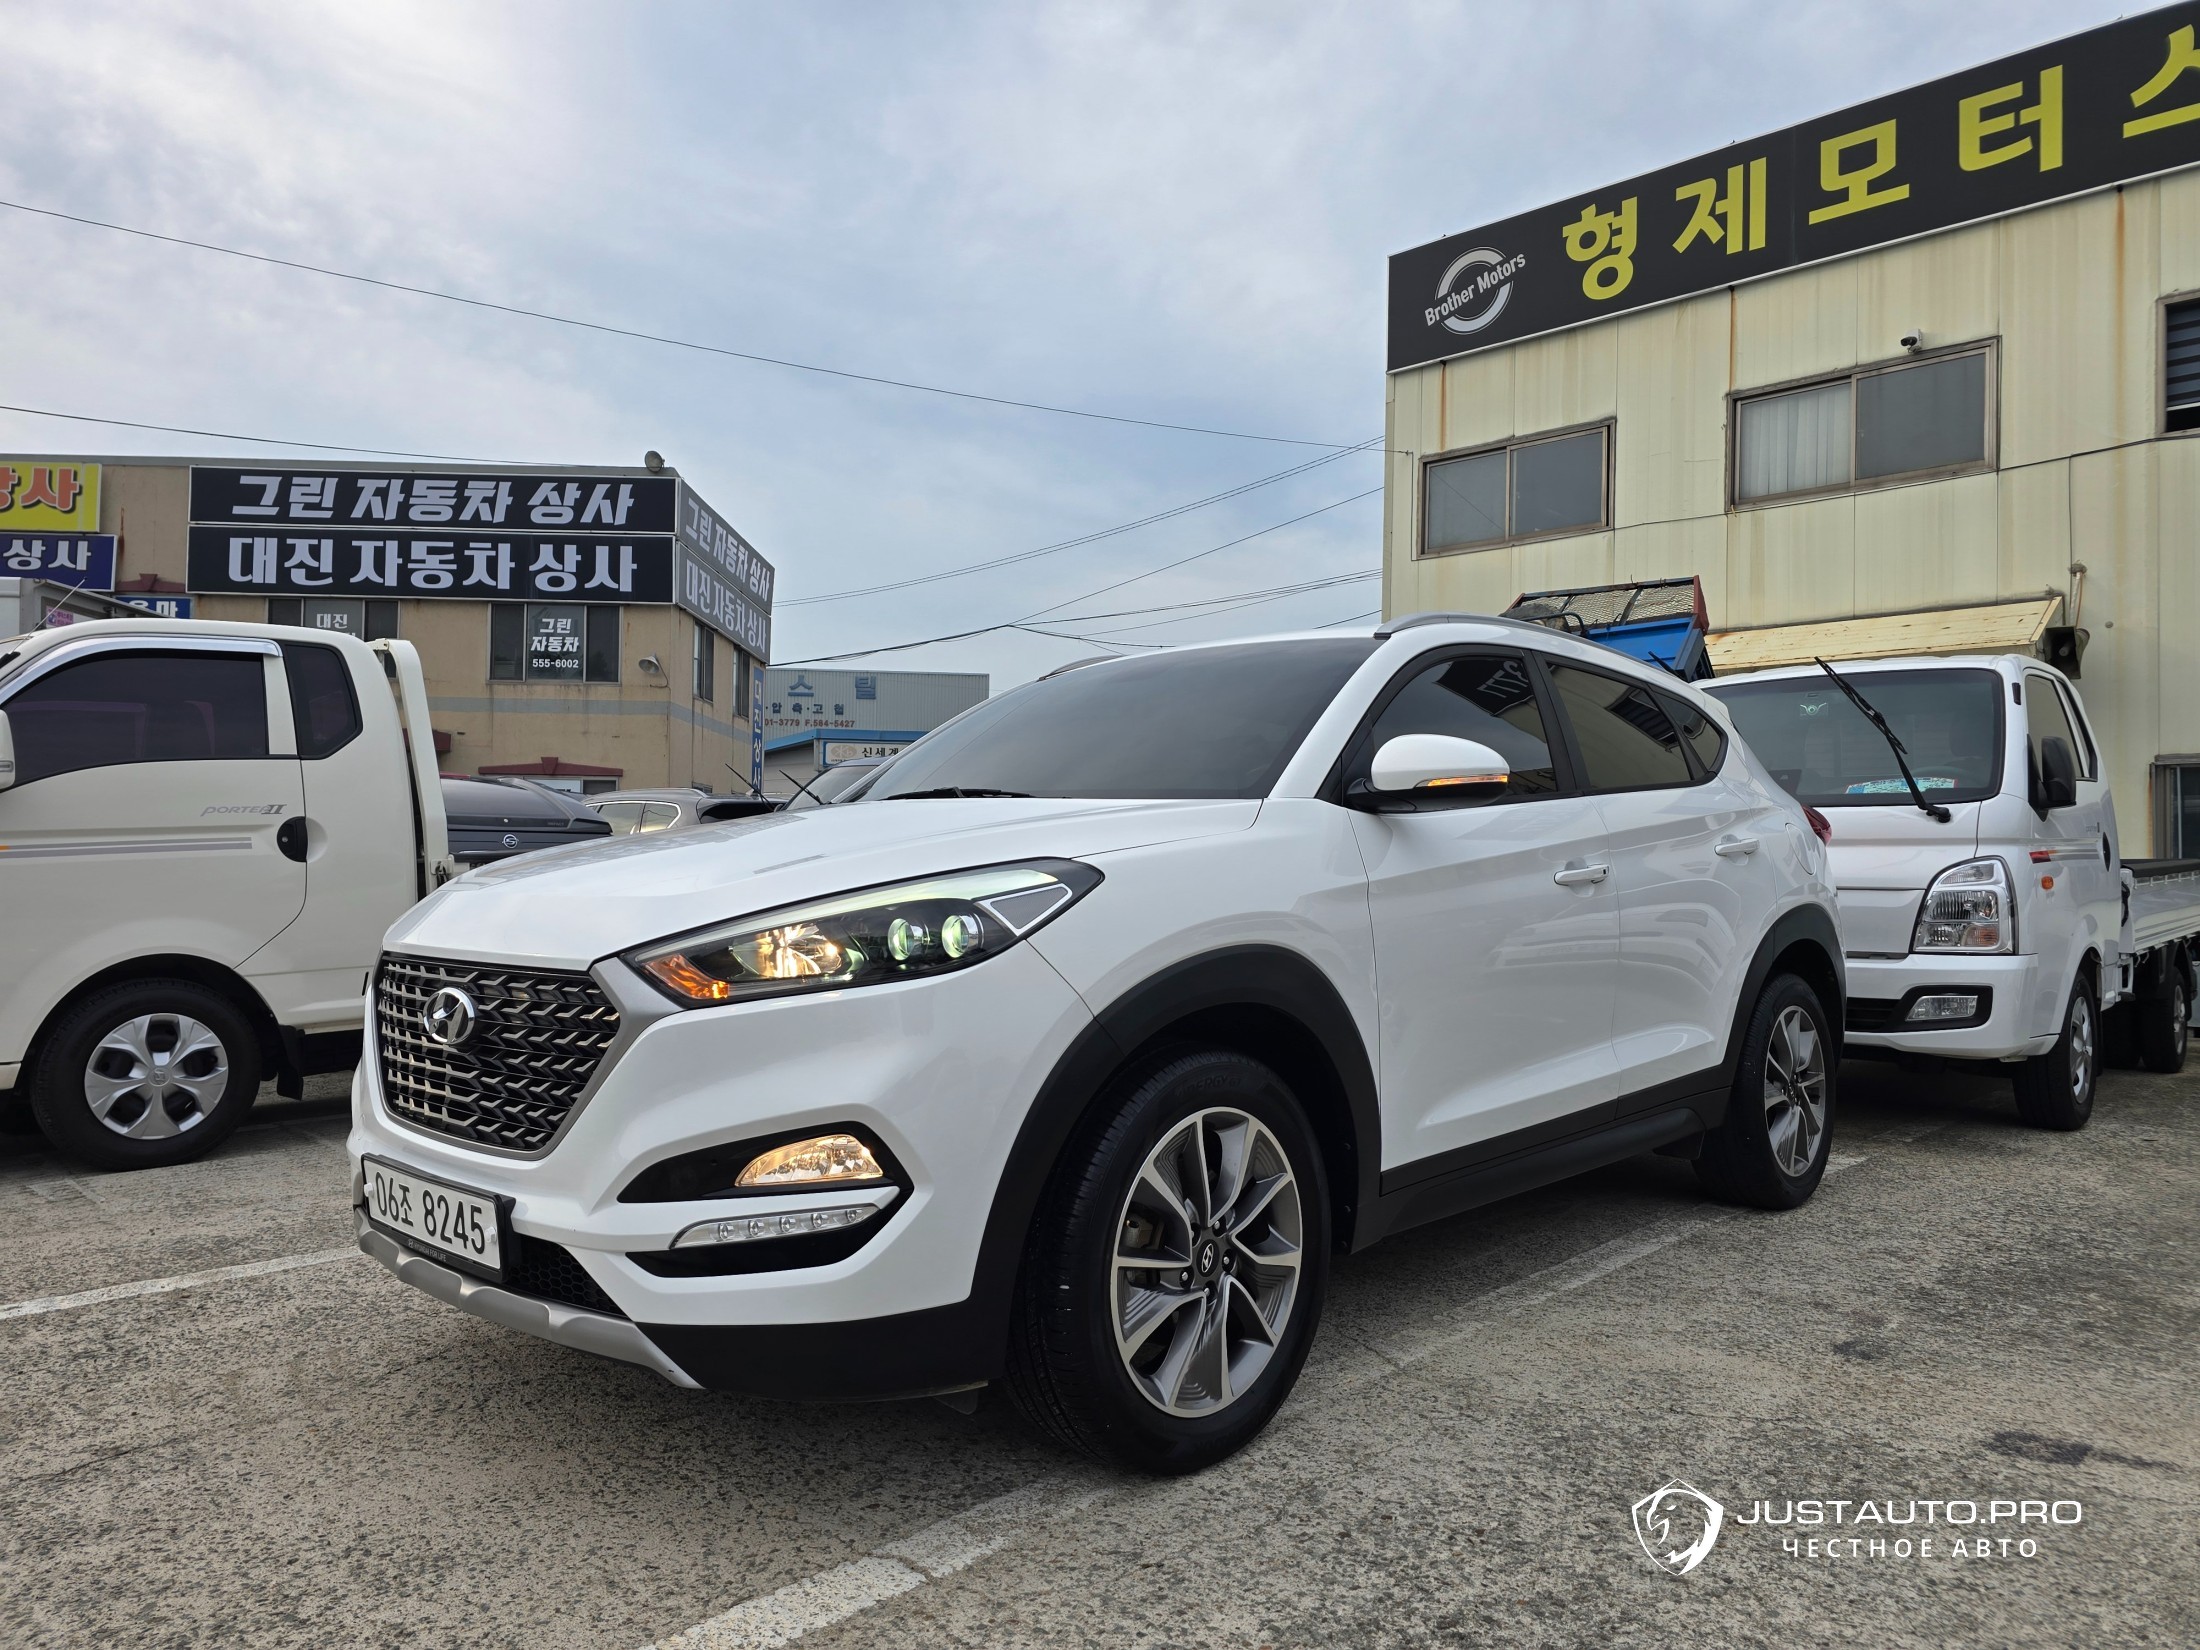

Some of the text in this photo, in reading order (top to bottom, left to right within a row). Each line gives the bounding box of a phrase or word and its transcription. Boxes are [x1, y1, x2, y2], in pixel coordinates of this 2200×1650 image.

[1425, 253, 1526, 326] Brother Motors
[232, 475, 635, 526] 그린 자동차 상사
[2, 539, 92, 572] 상사
[227, 536, 638, 593] 대진 자동차 상사
[685, 497, 771, 602] 그린 자동차 상사
[316, 613, 348, 629] 대진
[540, 618, 572, 634] 그린
[685, 558, 767, 654] 대진 자동차 상사
[530, 636, 580, 652] 자동차
[532, 658, 579, 668] 555-6002
[375, 1172, 486, 1255] 06조 8245
